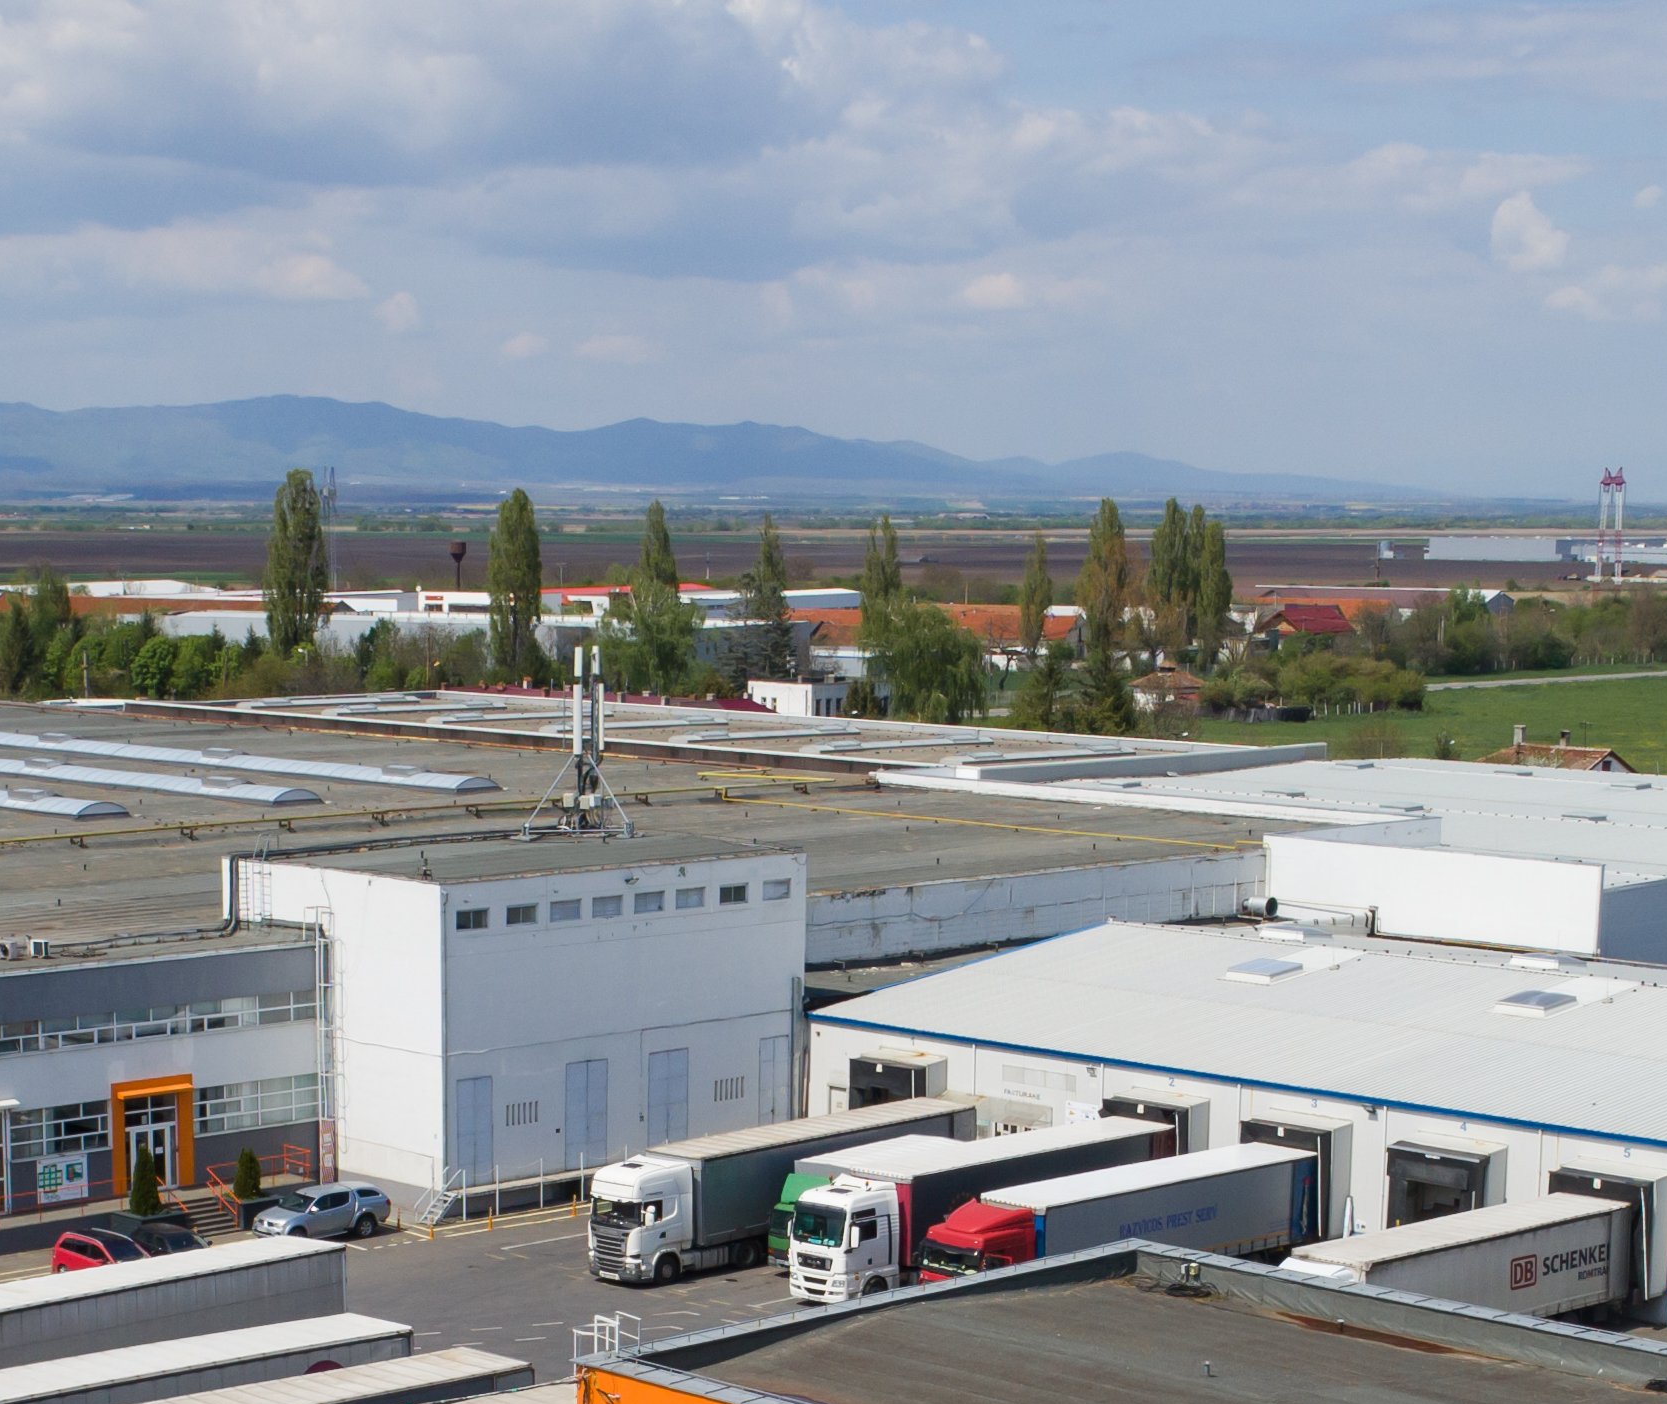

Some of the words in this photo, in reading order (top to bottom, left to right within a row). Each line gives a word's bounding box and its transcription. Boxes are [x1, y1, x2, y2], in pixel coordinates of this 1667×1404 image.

[1168, 1077, 1175, 1087] 2
[1310, 1098, 1318, 1109] 3
[1459, 1121, 1467, 1131] 4
[1623, 1147, 1631, 1158] 5
[1166, 1211, 1193, 1229] PREST
[1195, 1204, 1218, 1223] SERV
[1578, 1265, 1609, 1280] ROMTRA
